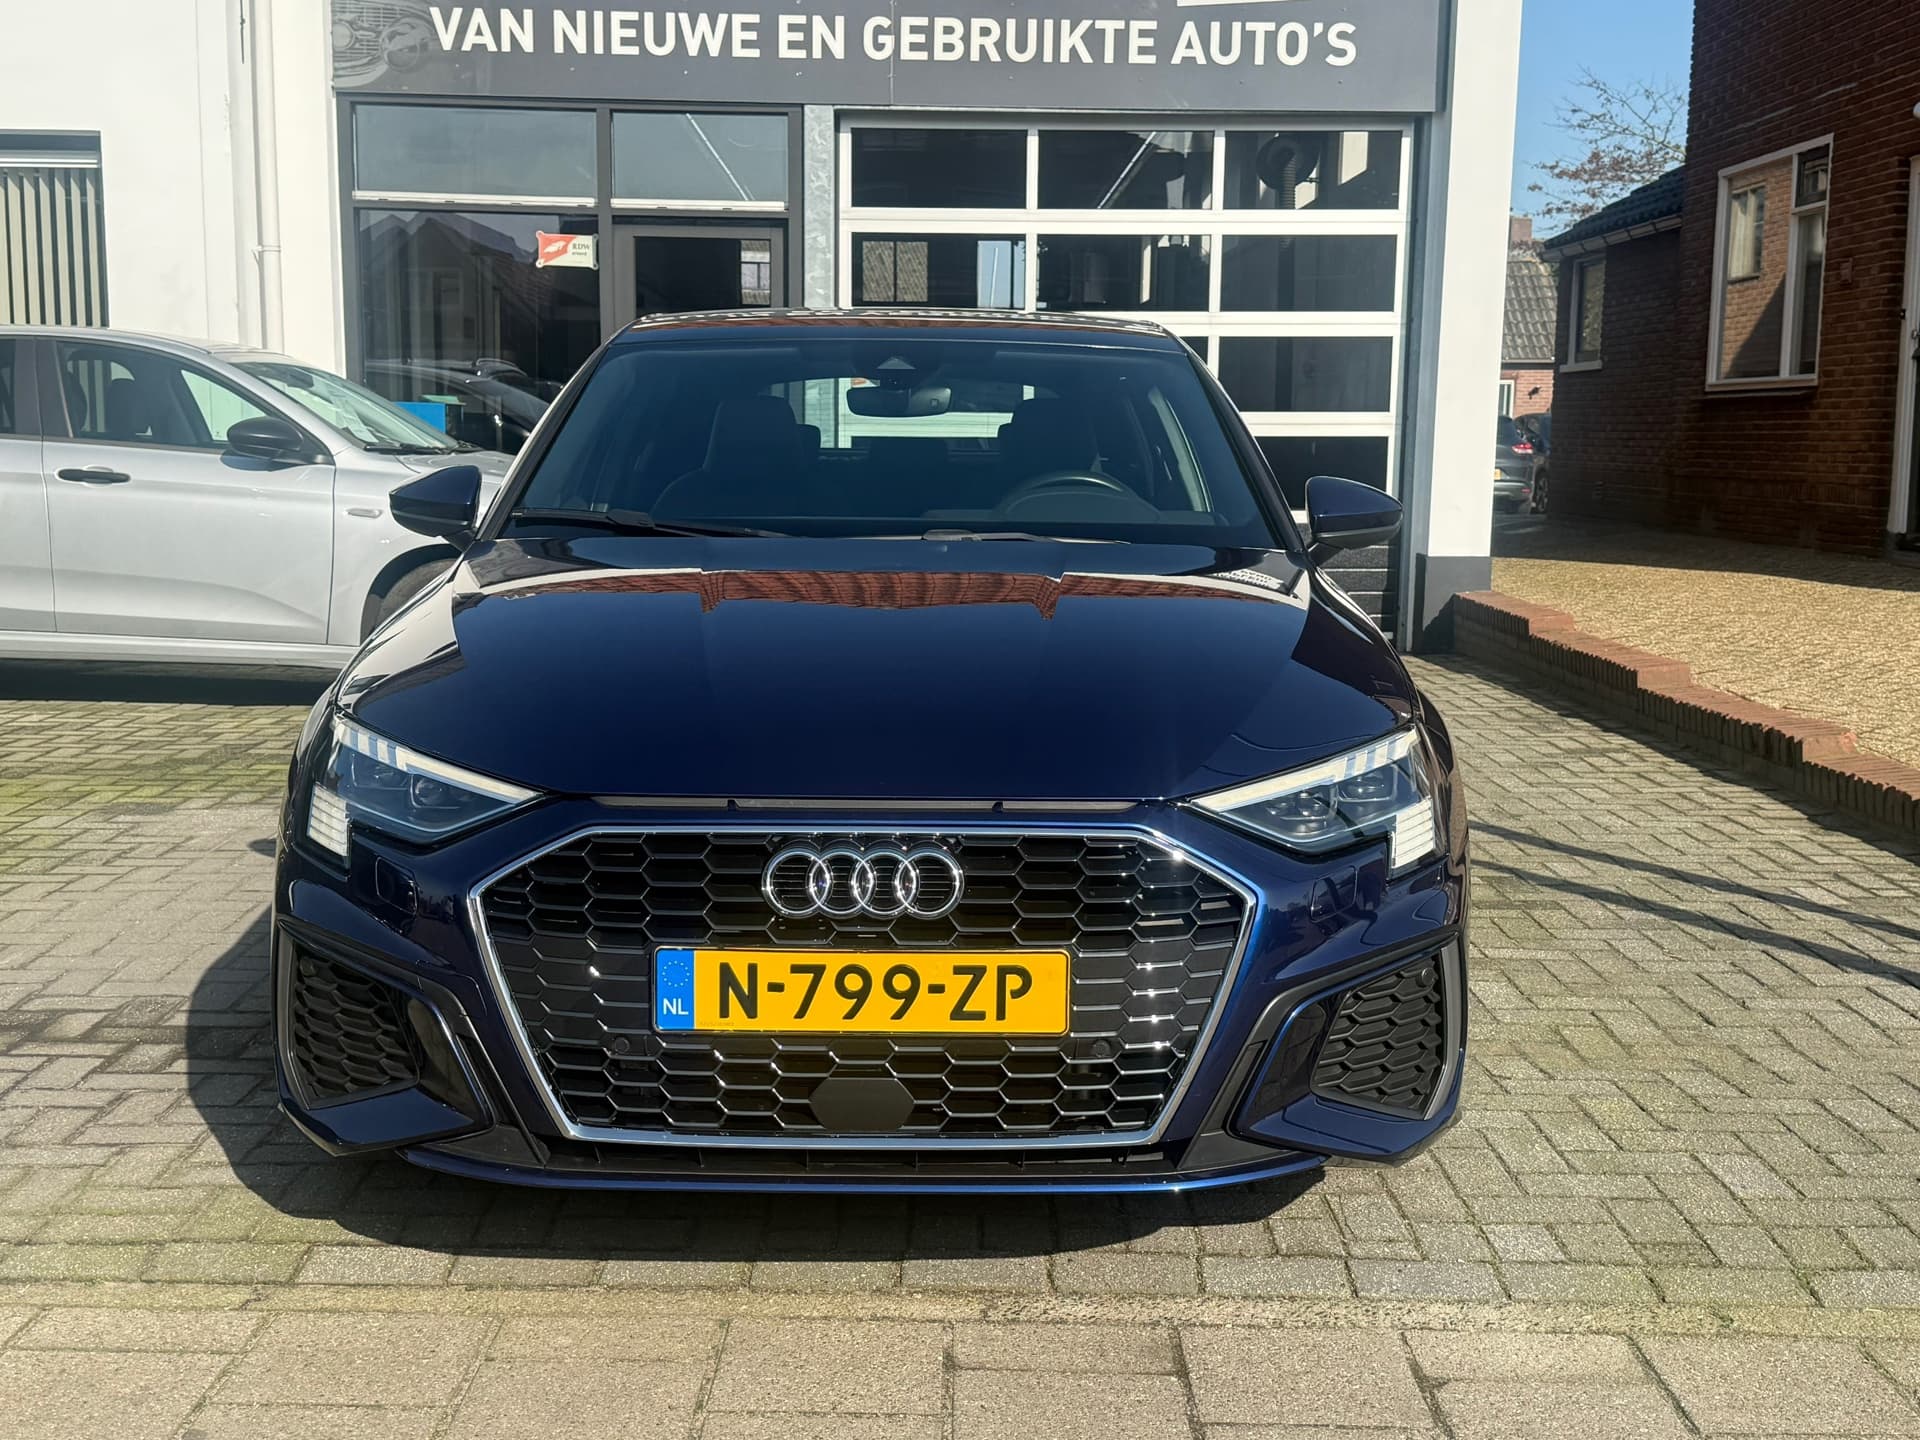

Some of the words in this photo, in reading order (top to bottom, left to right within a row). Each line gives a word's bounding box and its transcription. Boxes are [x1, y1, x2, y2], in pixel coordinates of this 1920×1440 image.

[429, 7, 533, 53] VAN
[553, 10, 760, 57] NIEUWE
[777, 15, 845, 59] EN
[863, 16, 1157, 65] GEBRUIKTE
[1170, 21, 1357, 66] AUTO'S
[663, 998, 689, 1015] NL
[719, 962, 1033, 1021] N-799-ZP
